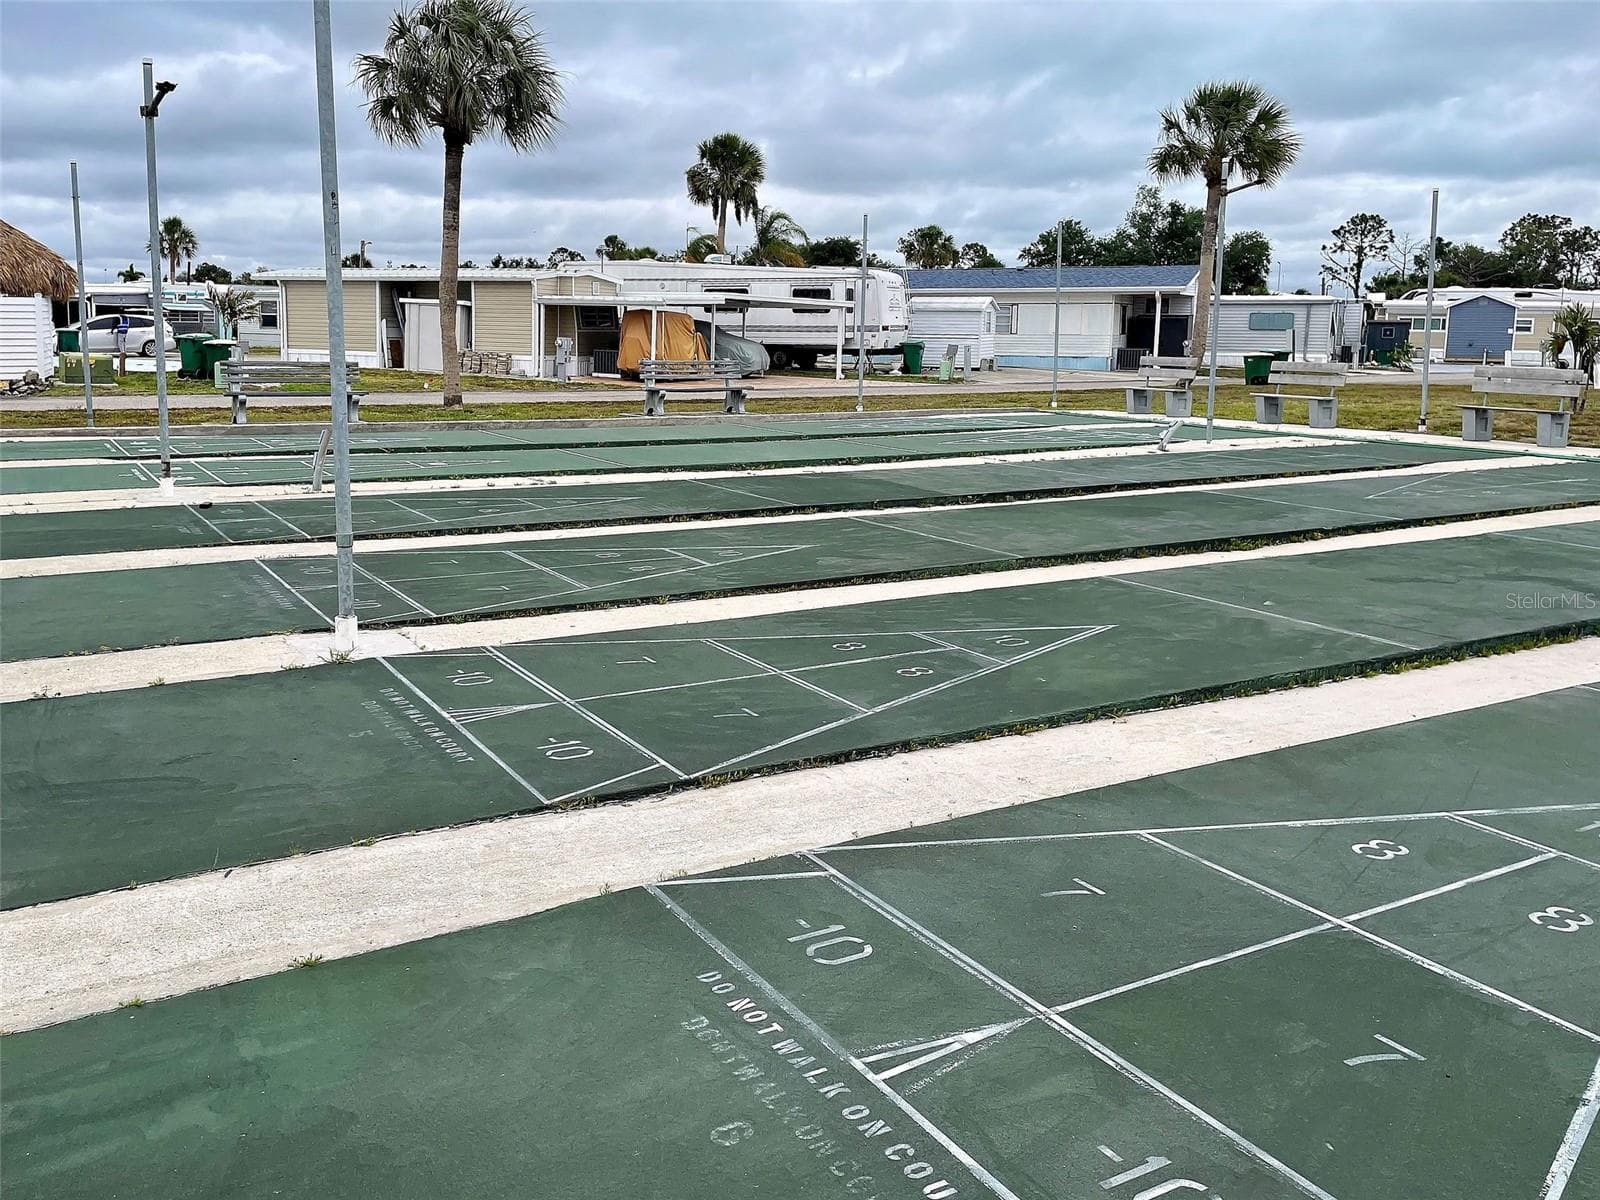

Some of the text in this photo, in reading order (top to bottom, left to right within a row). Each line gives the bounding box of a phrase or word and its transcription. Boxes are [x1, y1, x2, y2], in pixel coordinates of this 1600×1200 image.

[831, 641, 867, 651] 8
[984, 635, 1030, 647] 10
[615, 655, 657, 664] 7
[445, 668, 495, 687] -10
[896, 666, 934, 678] 8
[712, 707, 760, 718] 7
[436, 737, 475, 763] COURT
[535, 736, 595, 761] -10
[1351, 838, 1410, 860] 8
[1042, 877, 1107, 896] 7
[1527, 905, 1595, 934] 8
[786, 917, 874, 966] -10
[695, 970, 737, 994] DO
[726, 997, 785, 1035] NOT
[771, 1038, 851, 1100] WALK
[841, 1104, 894, 1139] ON
[1343, 1033, 1428, 1067] 7
